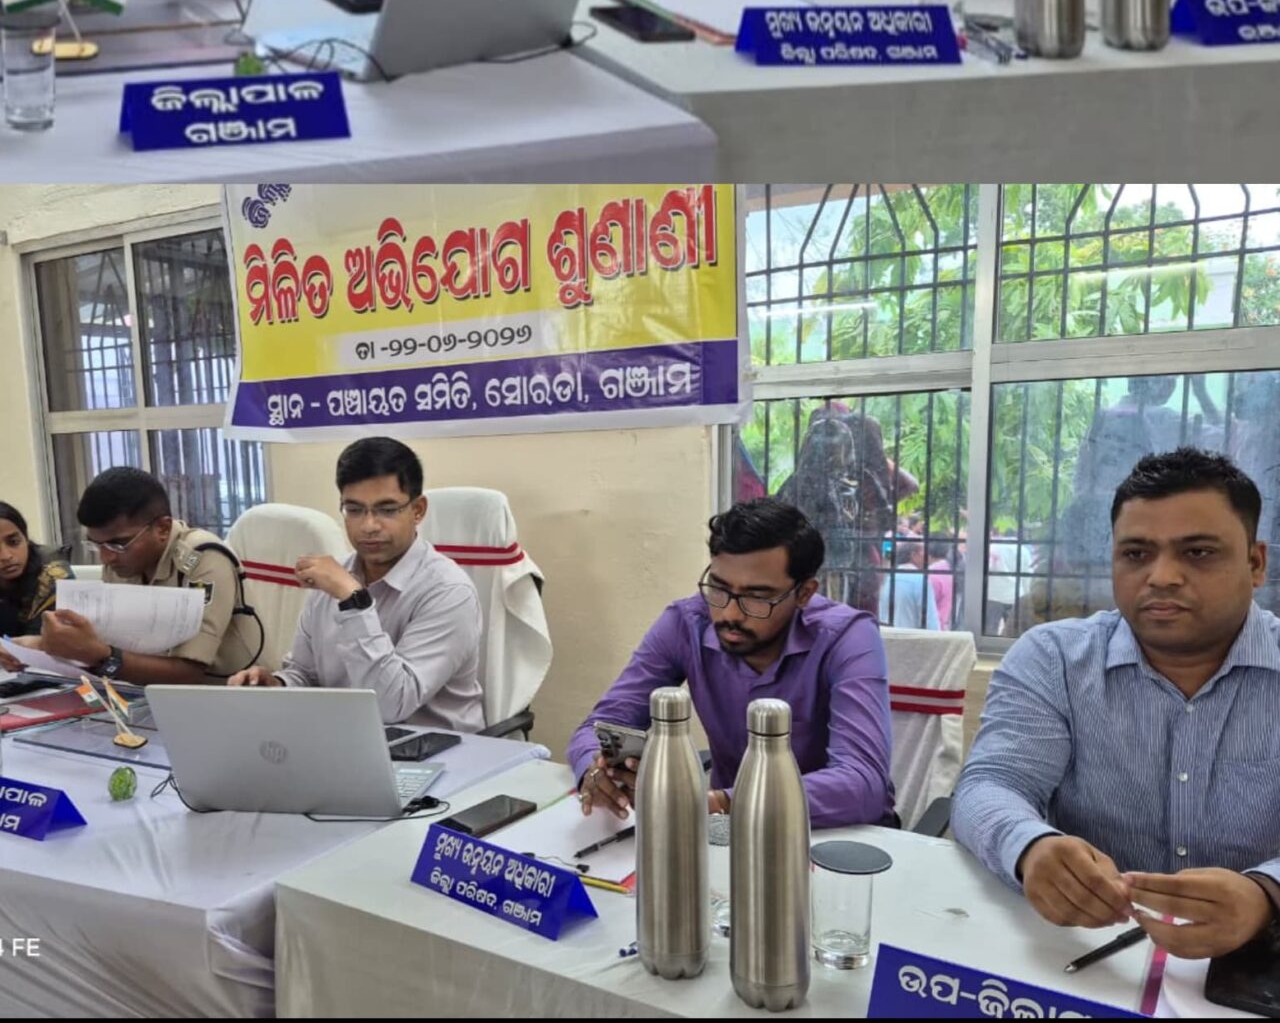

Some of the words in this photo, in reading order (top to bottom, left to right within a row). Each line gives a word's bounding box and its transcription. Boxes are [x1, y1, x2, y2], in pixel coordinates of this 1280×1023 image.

[151, 81, 324, 113] ଜିଲ୍ଲାପାଳ
[185, 117, 297, 143] ଗଞ୍ଜାମ
[243, 238, 333, 325] ମିଳିତ
[344, 218, 531, 313] ଅଭିଯୋଗ
[547, 184, 718, 308] ଶୁଣାଣୀ
[267, 393, 304, 426] ସ୍ଥାନ
[327, 386, 407, 417] ପଞ୍ଚାୟତ
[599, 362, 692, 399] ଗଞ୍ଜାମ
